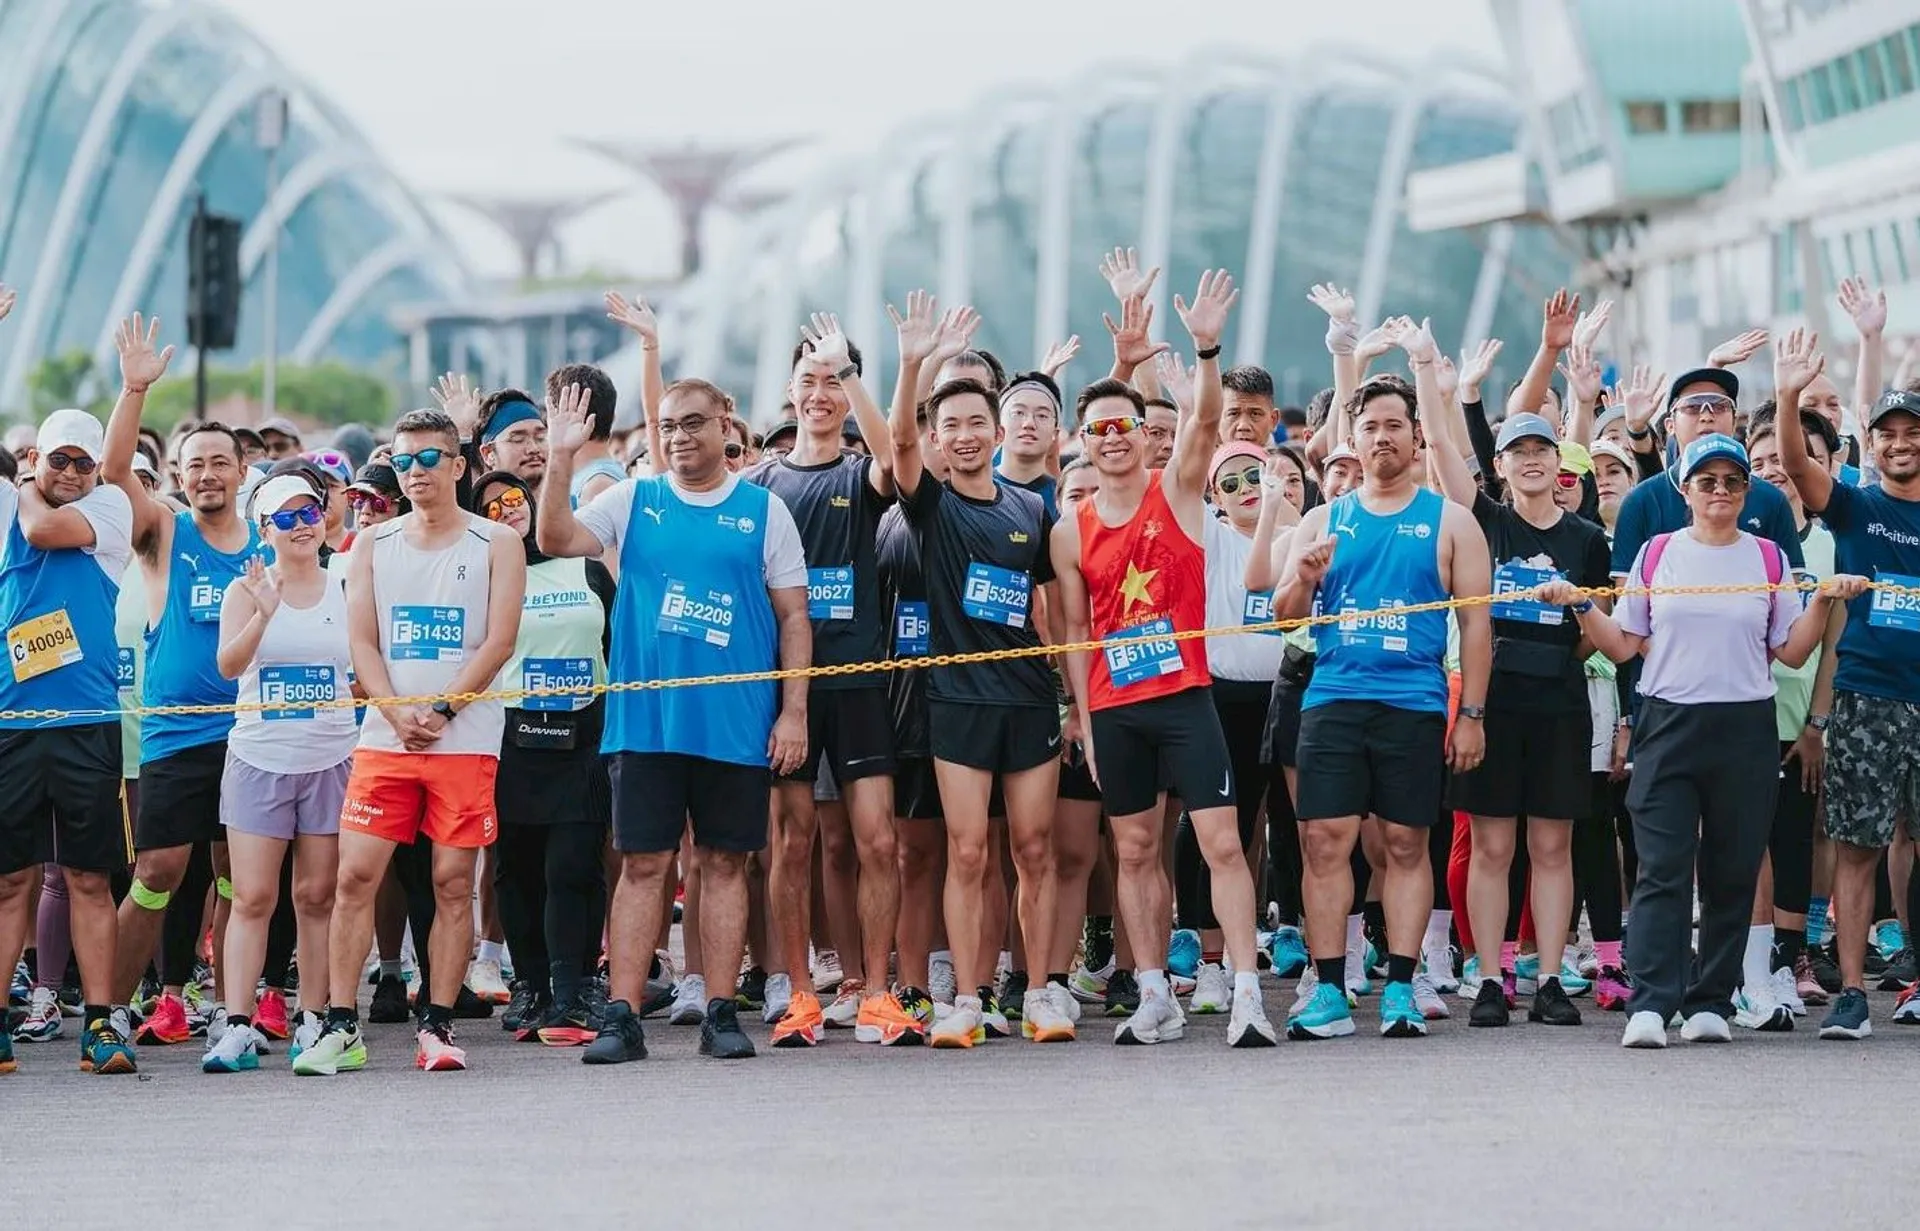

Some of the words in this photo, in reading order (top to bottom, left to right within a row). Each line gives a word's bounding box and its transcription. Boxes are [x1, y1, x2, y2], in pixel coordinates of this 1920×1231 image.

[532, 591, 587, 605] BEYOND
[988, 585, 1028, 608] 53229
[683, 600, 733, 626] 52209
[27, 627, 74, 654] 40094
[412, 623, 462, 642] 51433
[285, 684, 334, 700] 50509
